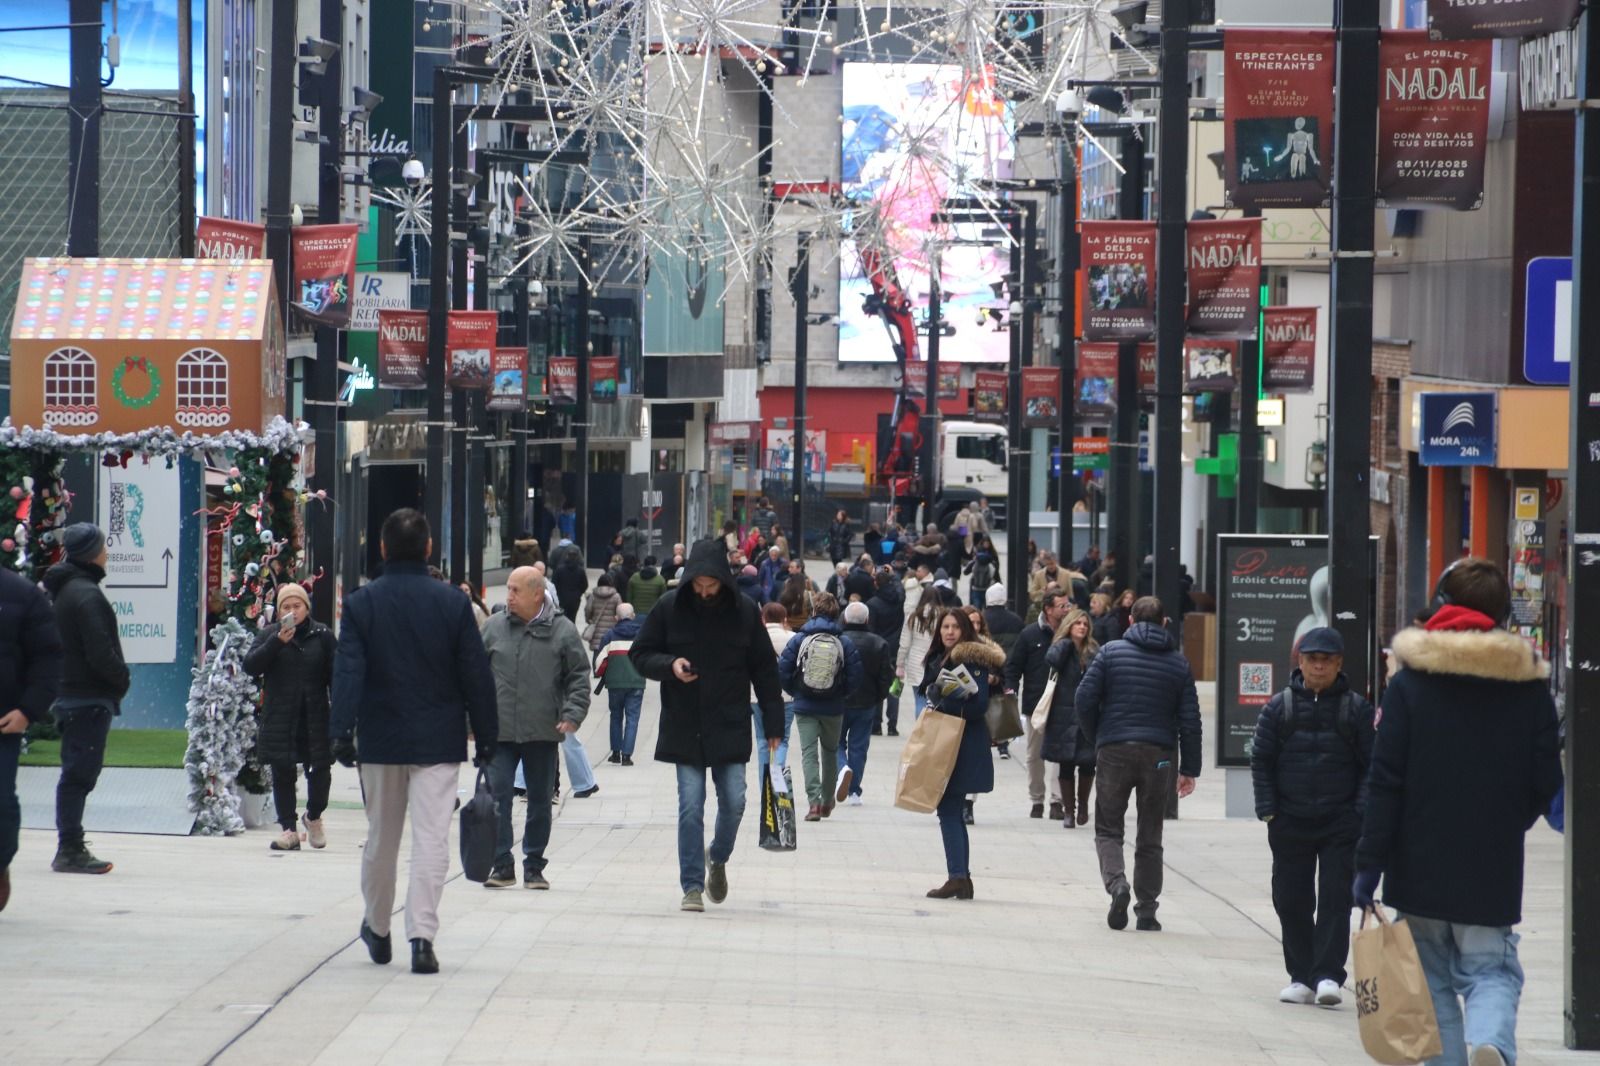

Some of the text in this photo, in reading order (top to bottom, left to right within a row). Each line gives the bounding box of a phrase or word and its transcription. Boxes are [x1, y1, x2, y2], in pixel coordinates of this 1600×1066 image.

[1235, 52, 1323, 61] ESPECTACLES
[1404, 49, 1469, 61] EL POBLET
[1242, 62, 1315, 70] ITINERANTS
[1385, 67, 1487, 100] NADAL
[1396, 160, 1468, 168] 28/11/2025
[1398, 169, 1465, 177] 5/01/2026
[299, 238, 351, 246] ESPECTACLES
[1191, 243, 1258, 269] NADAL
[381, 325, 425, 342] NADAL
[1264, 324, 1315, 342] NADAL
[550, 367, 577, 377] NADAL
[1460, 446, 1480, 456] 24h
[1232, 575, 1308, 585] Eròtic Centre
[111, 601, 134, 615] ONA
[119, 624, 167, 638] MERCIAL
[1236, 617, 1251, 641] 3
